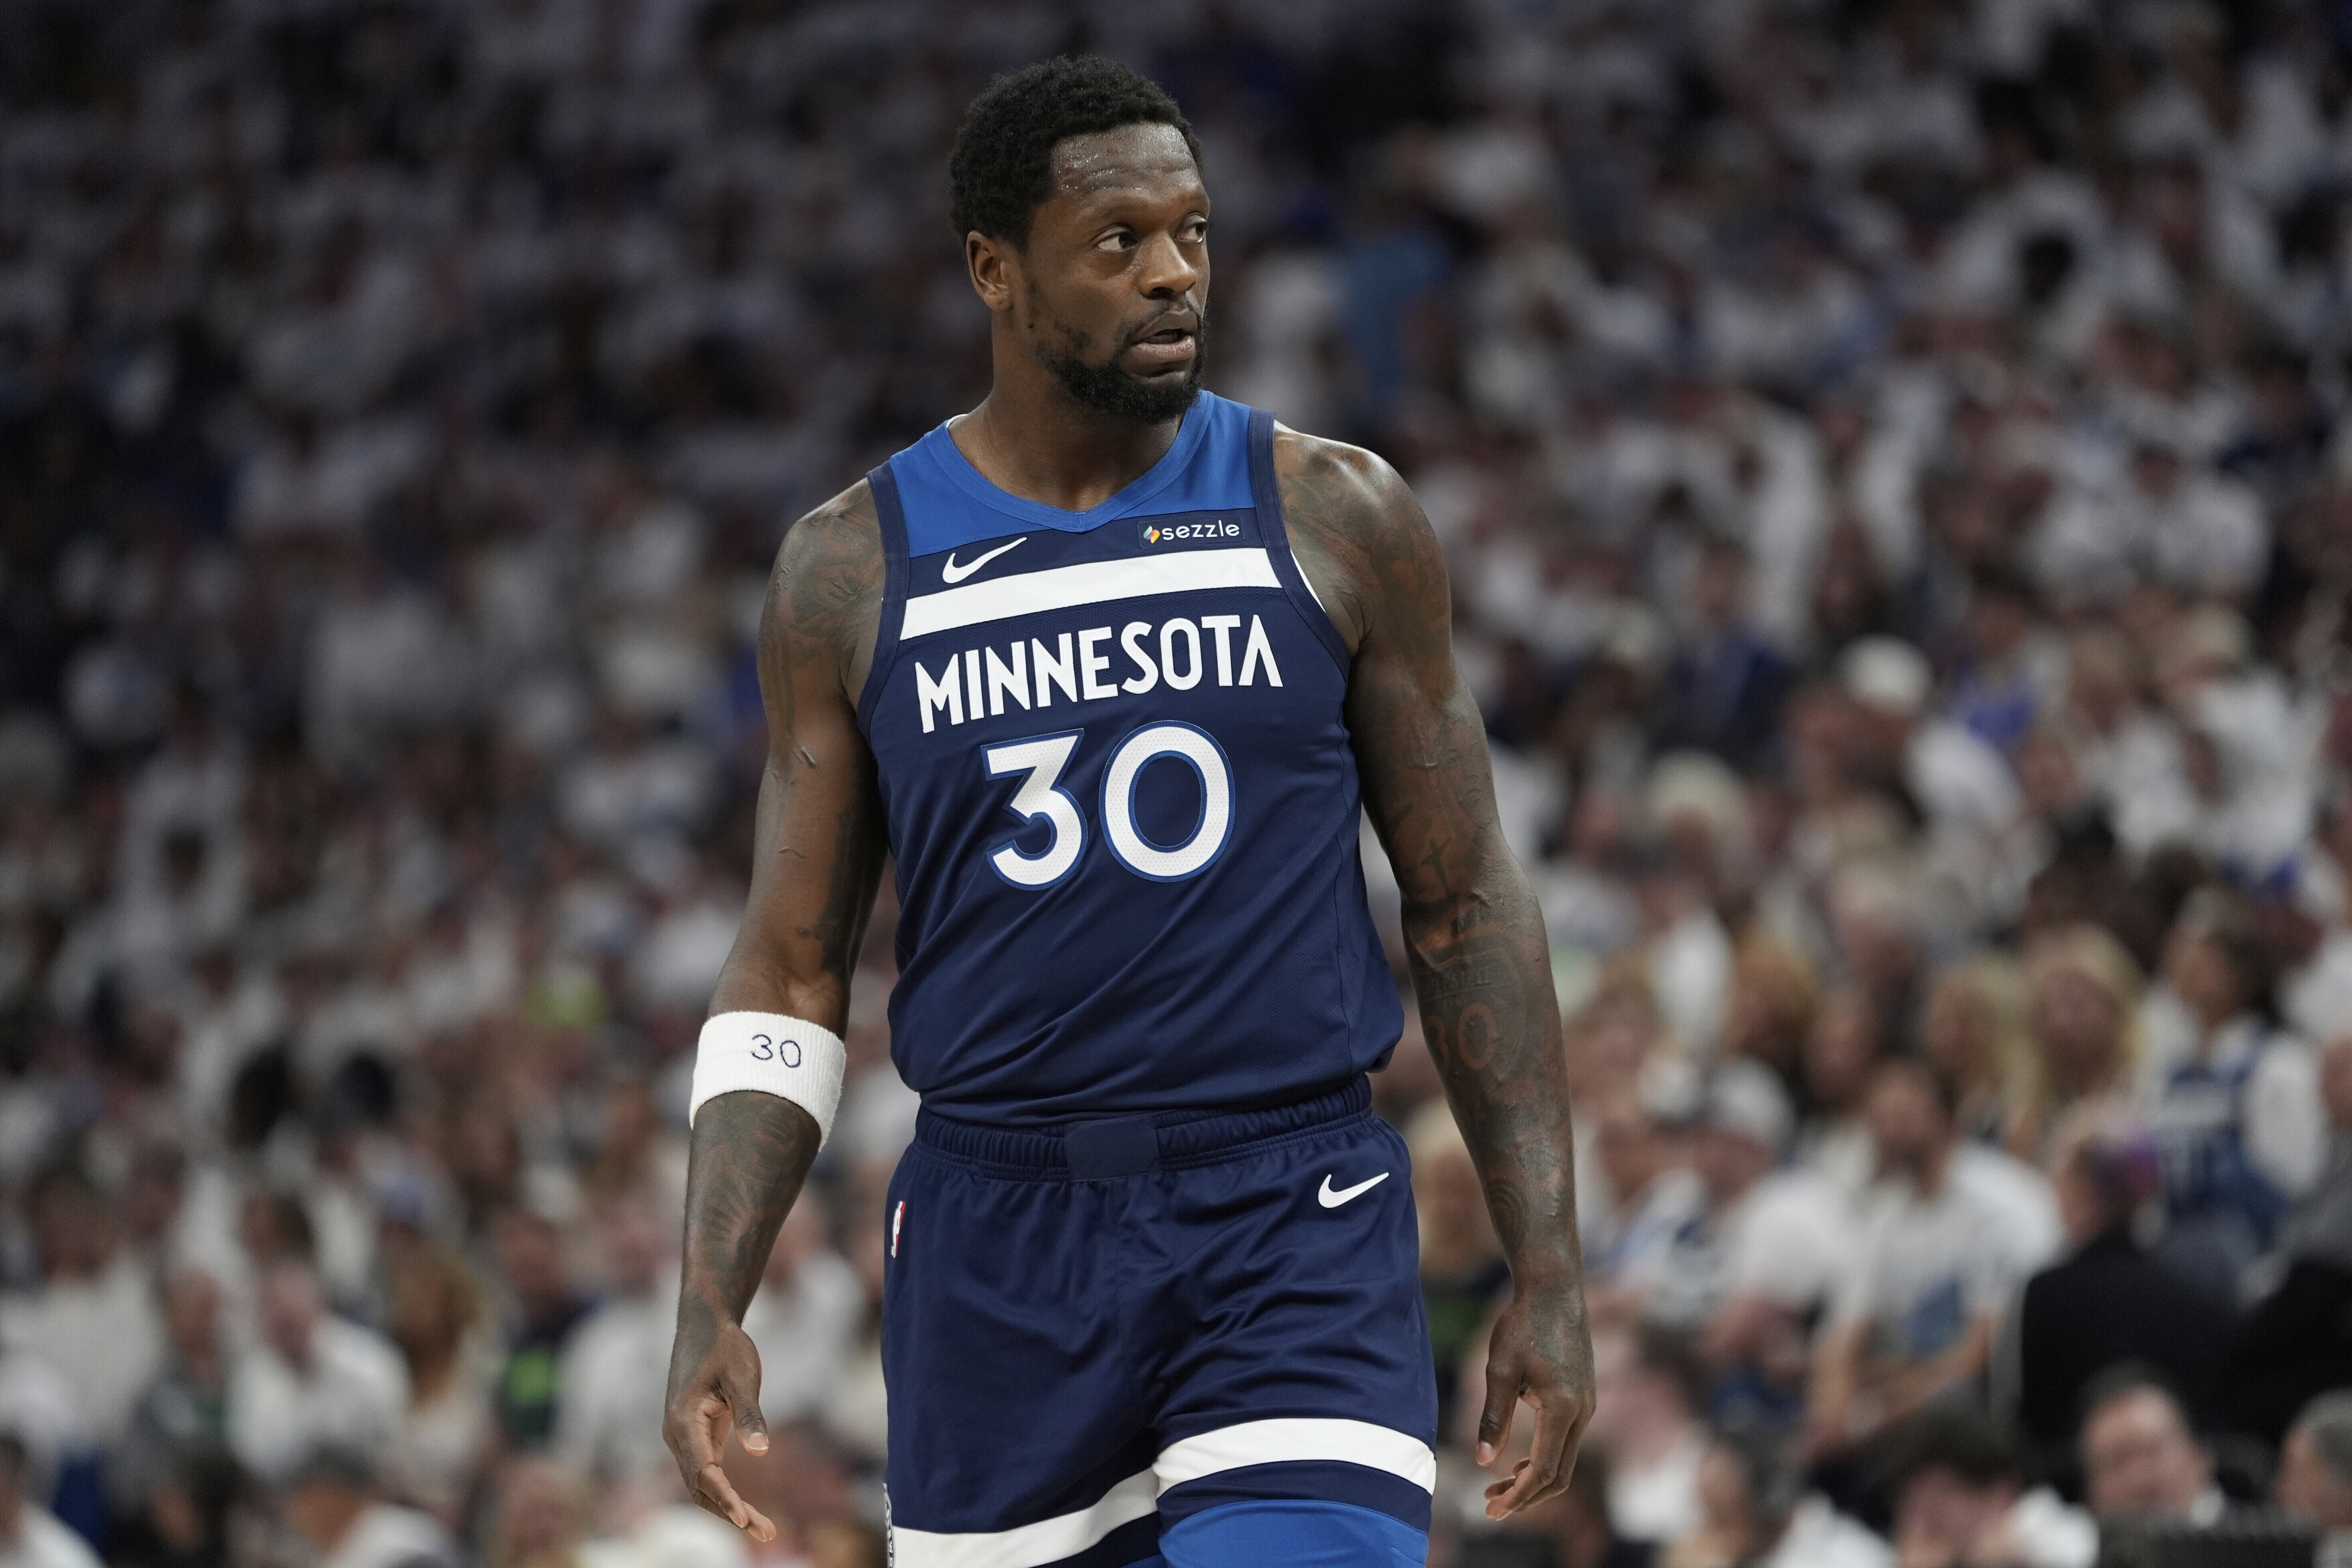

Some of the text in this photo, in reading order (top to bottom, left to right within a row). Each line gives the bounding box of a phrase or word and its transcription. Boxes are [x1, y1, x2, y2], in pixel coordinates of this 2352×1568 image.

[1161, 519, 1240, 541] sezzle
[915, 614, 1283, 733] MINNESOTA
[980, 720, 1236, 891] 30
[751, 1034, 802, 1068] 30
